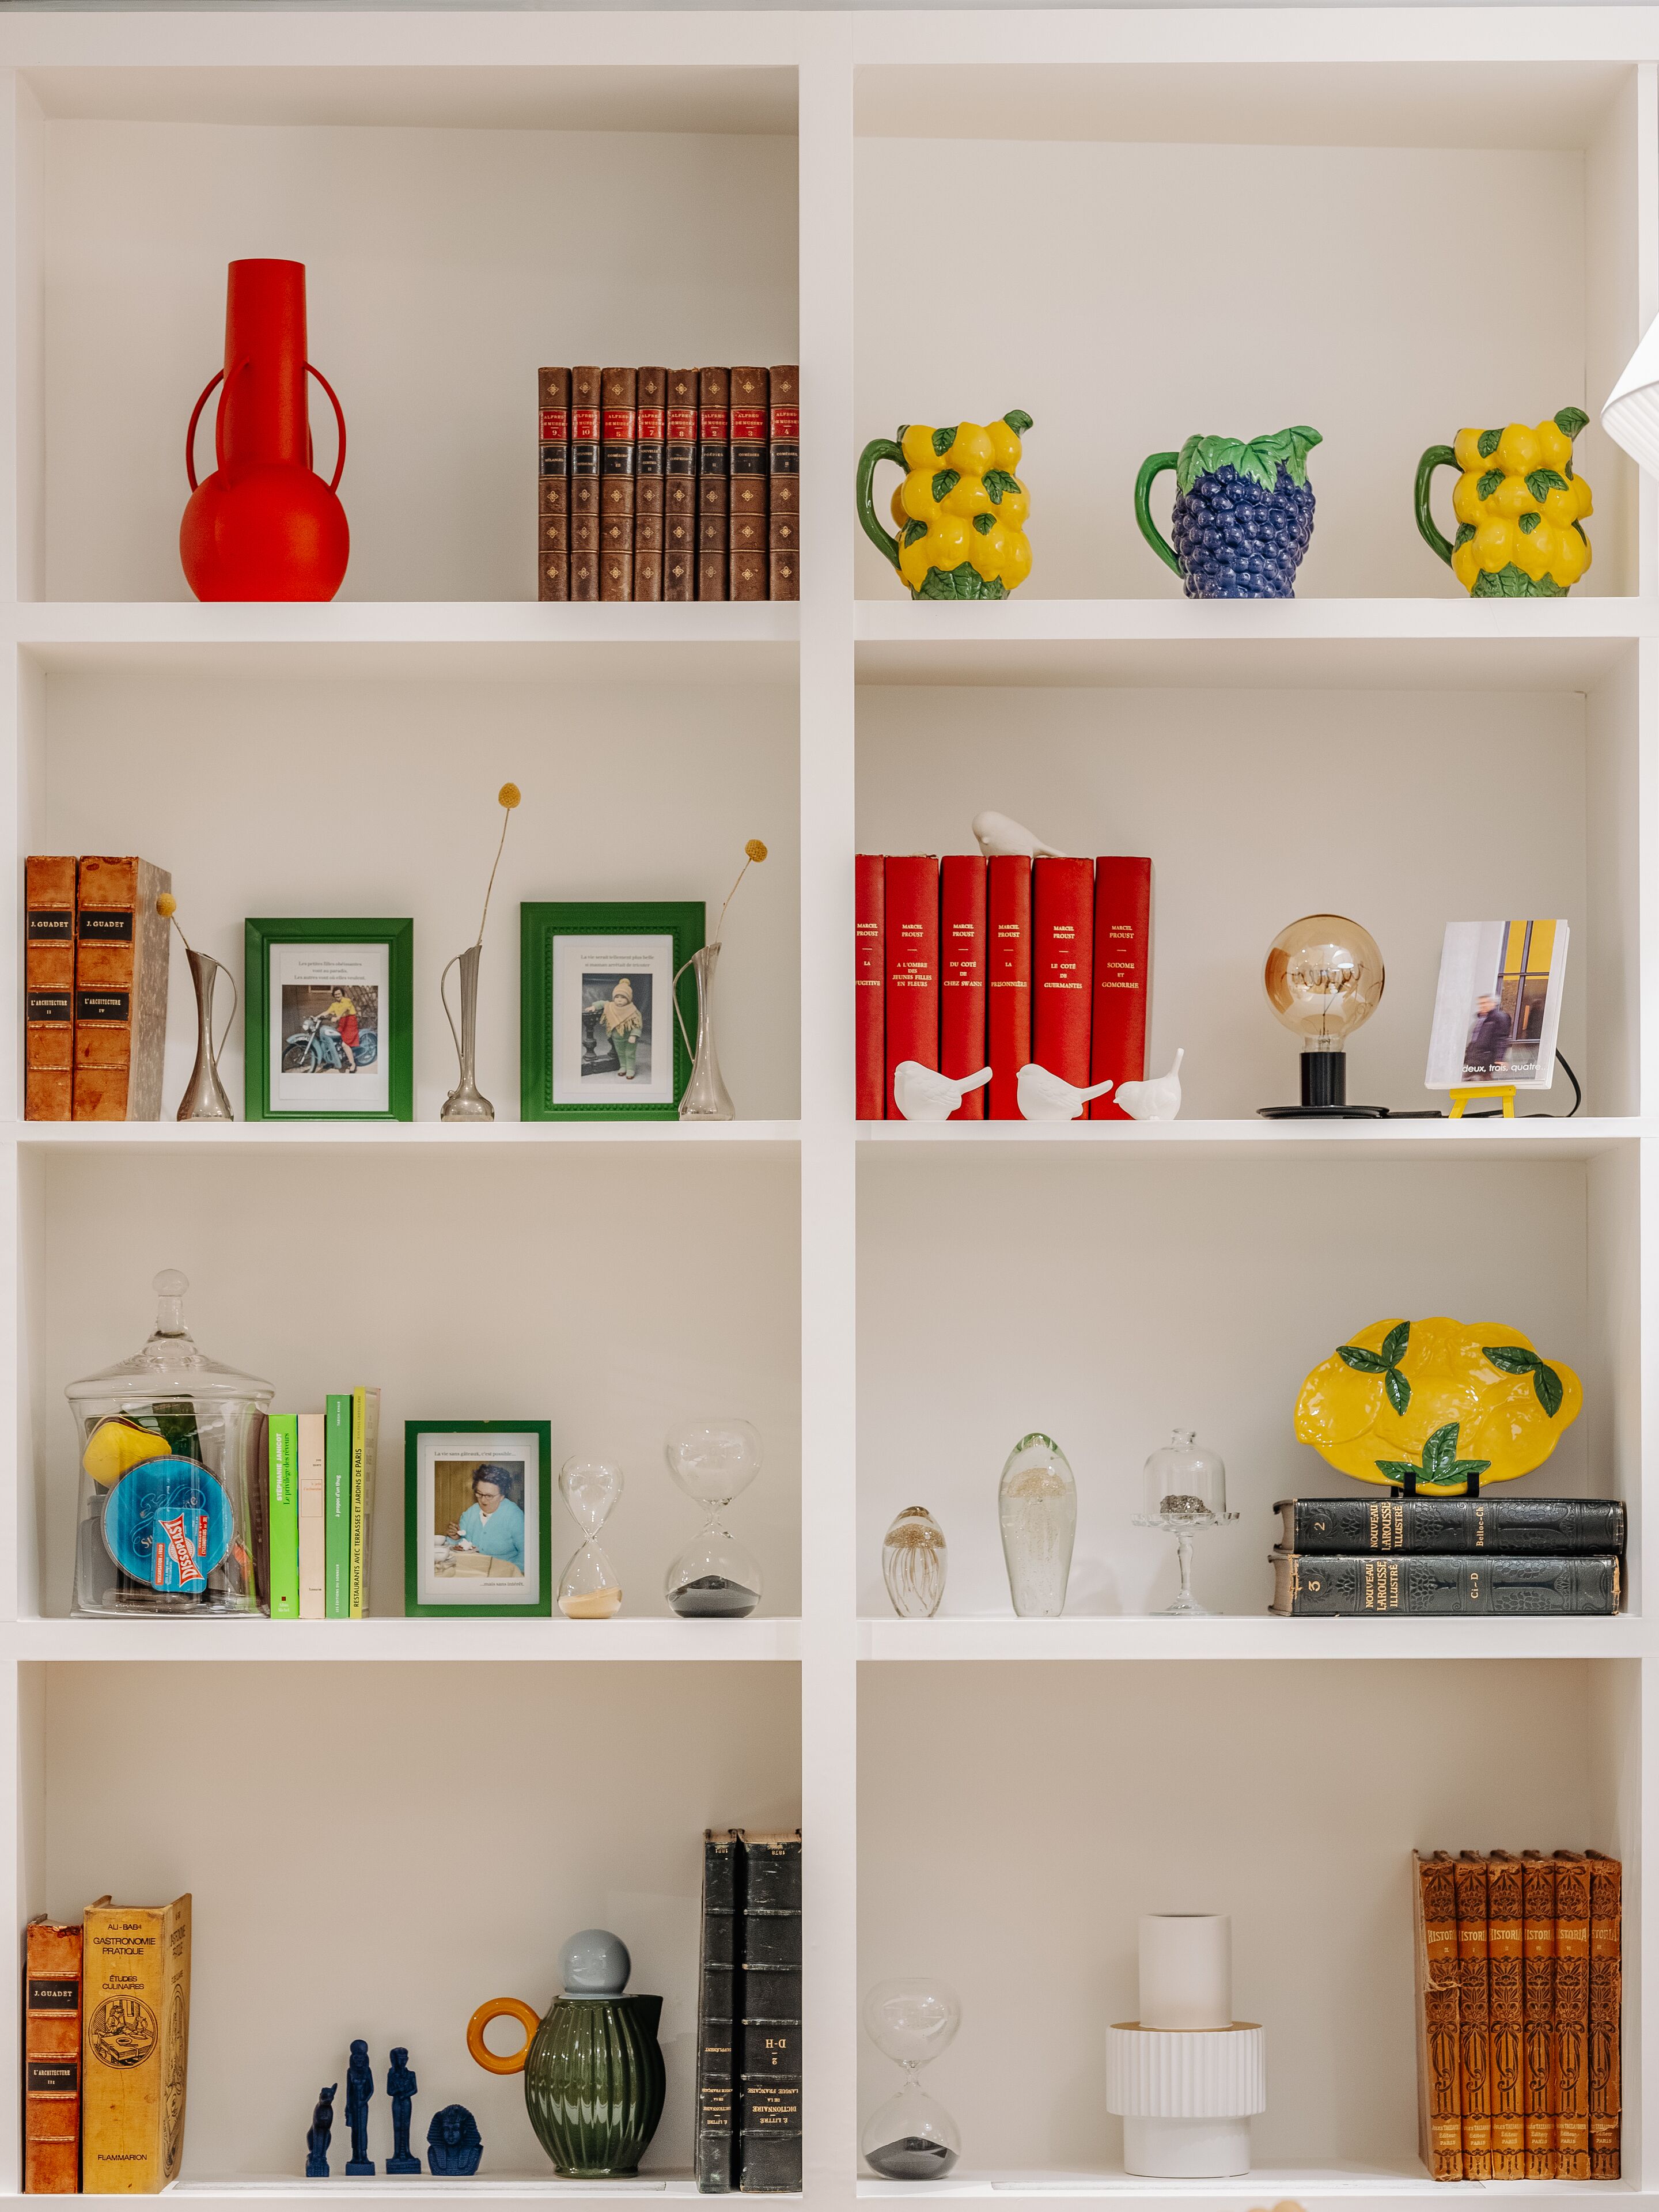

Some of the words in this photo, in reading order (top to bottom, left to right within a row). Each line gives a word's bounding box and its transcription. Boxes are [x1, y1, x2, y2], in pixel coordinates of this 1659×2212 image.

[283, 1469, 291, 1495] privilège
[283, 1497, 290, 1505] Le
[1314, 1522, 1325, 1531] 2
[1370, 1505, 1379, 1548] NOUVEAU
[1381, 1501, 1392, 1551] LAROUSSE
[1392, 1506, 1403, 1547] ILLUSTRÉ
[1476, 1506, 1484, 1546] Belloc-Ch
[164, 1520, 198, 1580] DISSOPLAST
[1309, 1581, 1320, 1592] 3
[1365, 1563, 1374, 1608] NOUVEAU
[1377, 1561, 1387, 1611] LAROUSSE
[1388, 1564, 1398, 1607] ILLUSTRÉ
[765, 2039, 786, 2048] D-H
